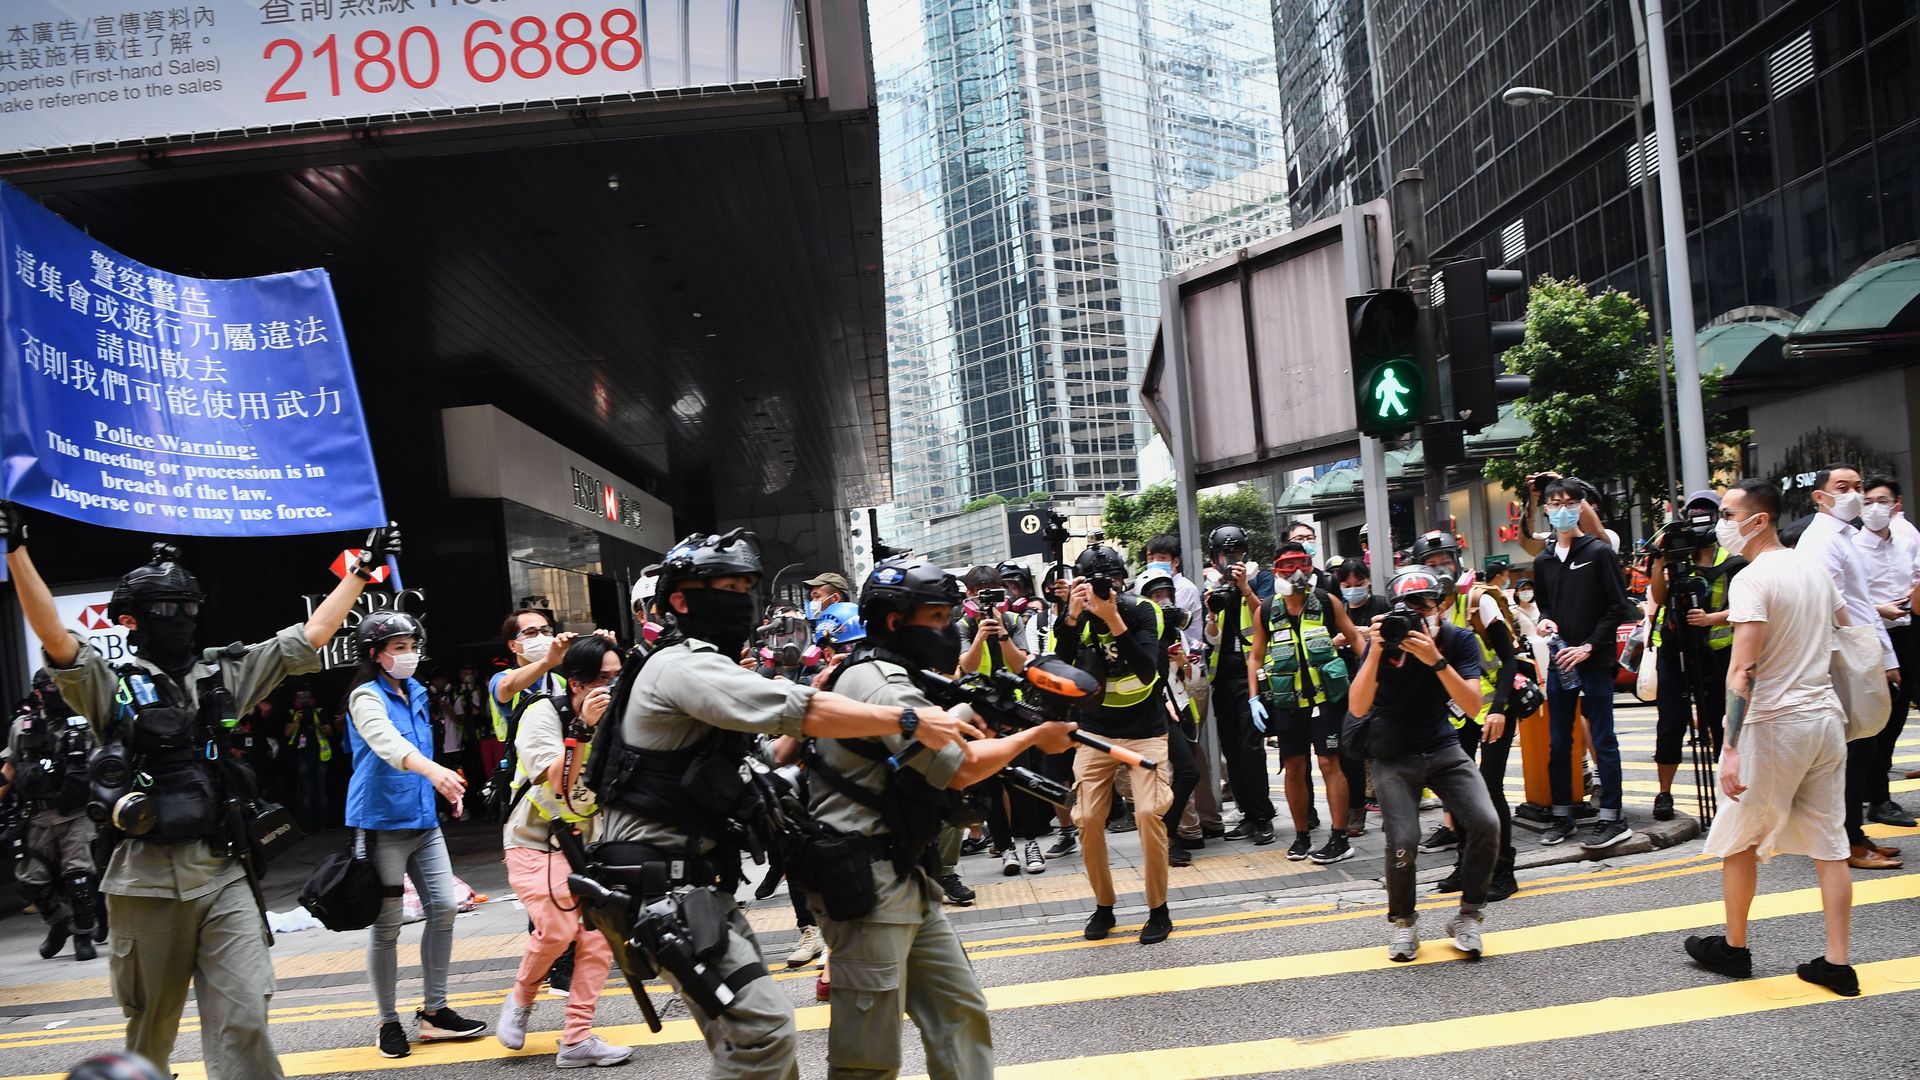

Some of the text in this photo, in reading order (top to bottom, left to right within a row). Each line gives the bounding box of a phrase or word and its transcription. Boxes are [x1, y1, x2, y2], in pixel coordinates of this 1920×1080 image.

[70, 61, 163, 88] (First-hand
[168, 55, 221, 75] Sales)
[262, 8, 642, 103] 2180 6888
[0, 77, 223, 114] ake reference to the sales
[15, 244, 328, 352] 這集會或遊行乃屬違法
[91, 250, 211, 314] 警察警告
[20, 328, 342, 421] 否則我們可能使用武力
[95, 328, 228, 384] 請即散去
[46, 430, 326, 480] This meeting or procession is in
[93, 420, 257, 461] Police Warning:
[50, 479, 333, 525] Disperse or we may use force.
[100, 470, 273, 501] breach of the law.
